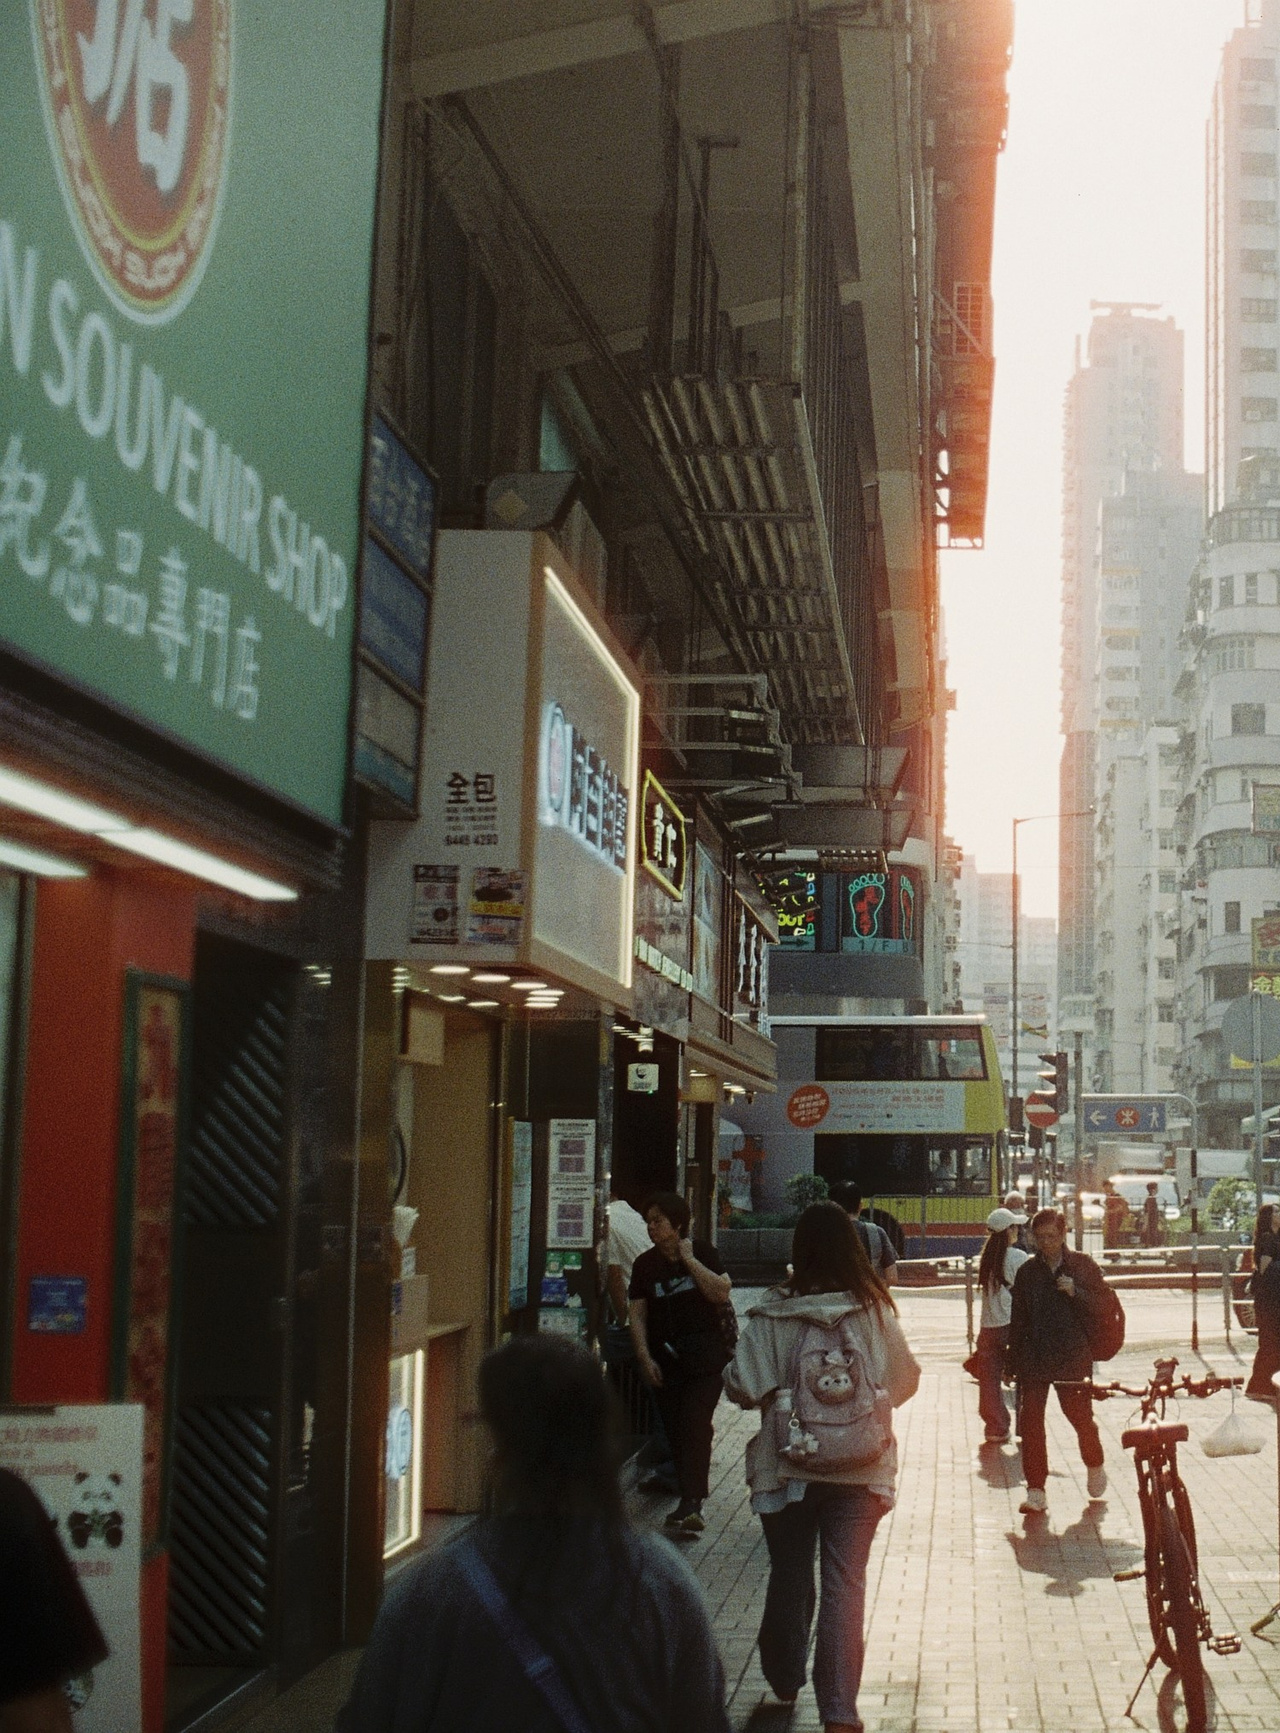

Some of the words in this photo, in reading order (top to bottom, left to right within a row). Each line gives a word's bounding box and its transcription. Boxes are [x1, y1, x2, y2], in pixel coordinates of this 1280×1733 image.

[41, 279, 261, 573] SOUVENIR
[265, 496, 348, 638] SHOP
[446, 772, 497, 804] 全包
